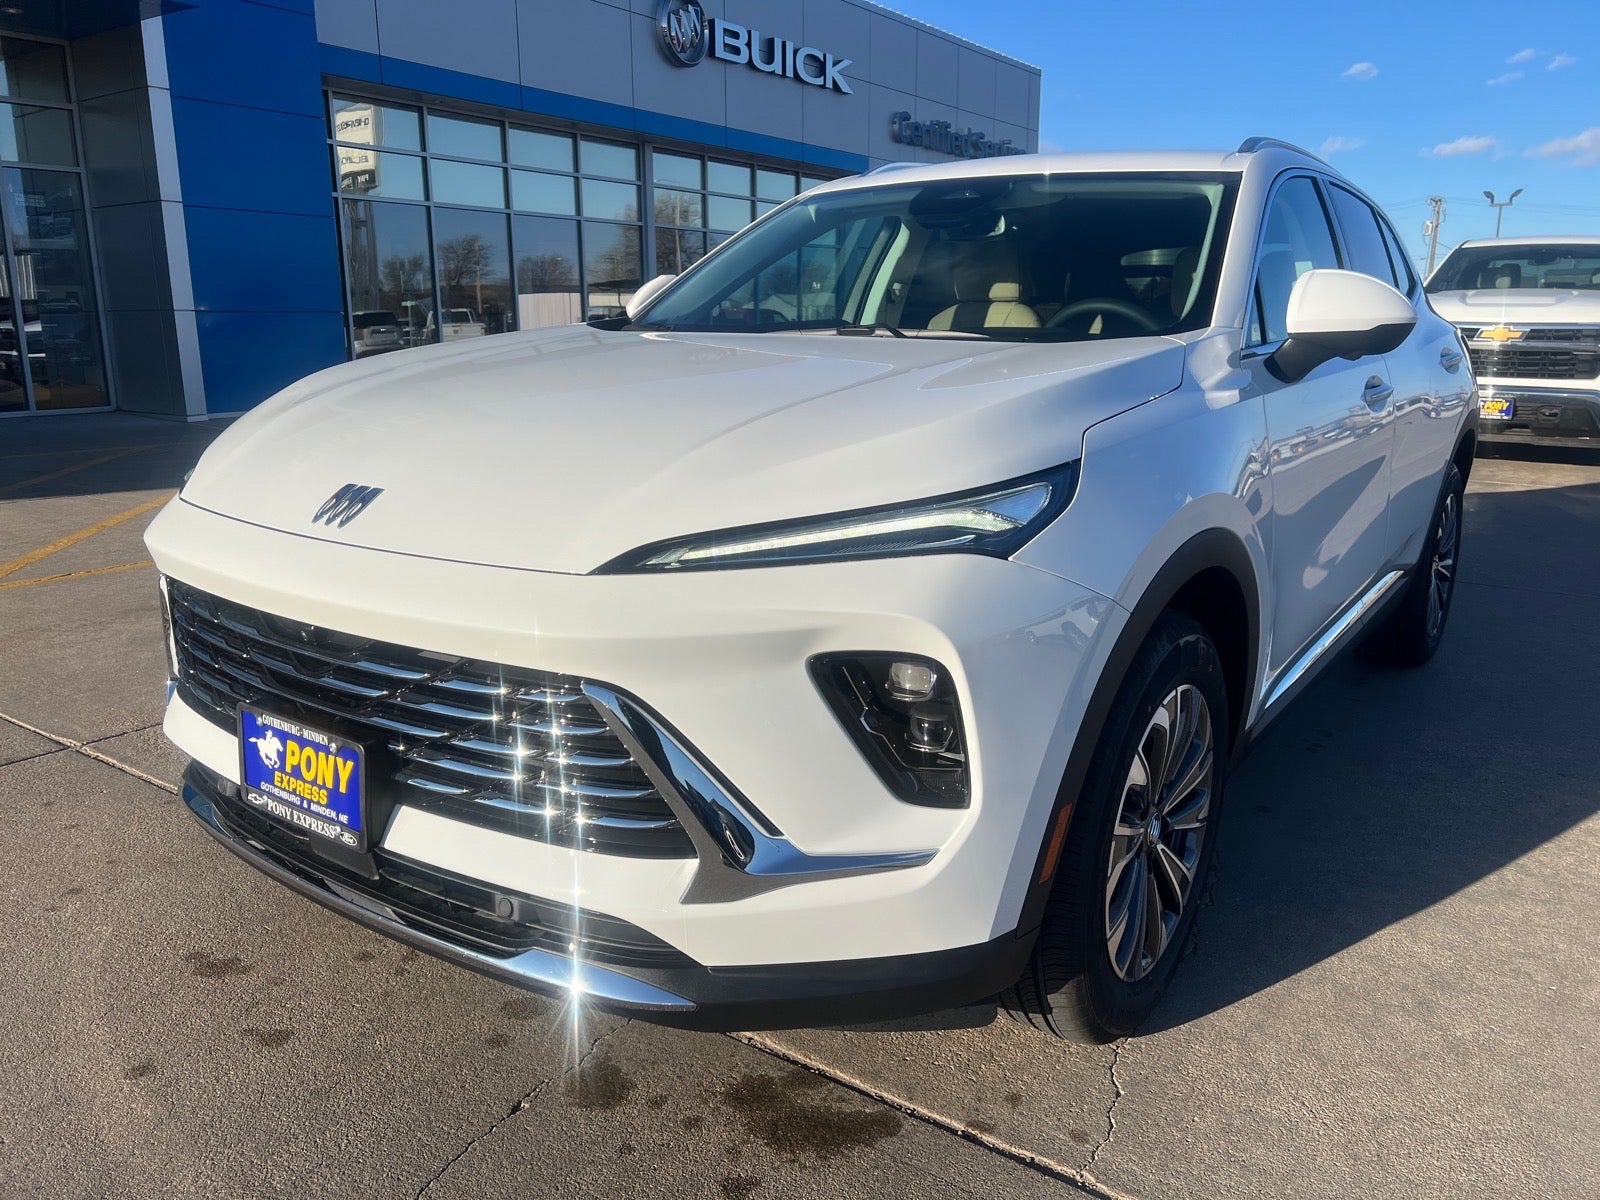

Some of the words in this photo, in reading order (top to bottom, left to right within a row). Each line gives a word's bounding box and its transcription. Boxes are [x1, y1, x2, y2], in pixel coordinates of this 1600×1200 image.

[712, 18, 854, 95] BUICK
[1484, 401, 1510, 410] PONY
[274, 771, 328, 805] EXPRESS
[285, 740, 354, 794] PONY
[260, 781, 301, 806] GOTHENBURG
[302, 799, 308, 809] &
[310, 803, 338, 822] MINDEN,
[338, 812, 349, 824] NE
[267, 798, 293, 821] PONY
[293, 810, 336, 840] EXPRESS
